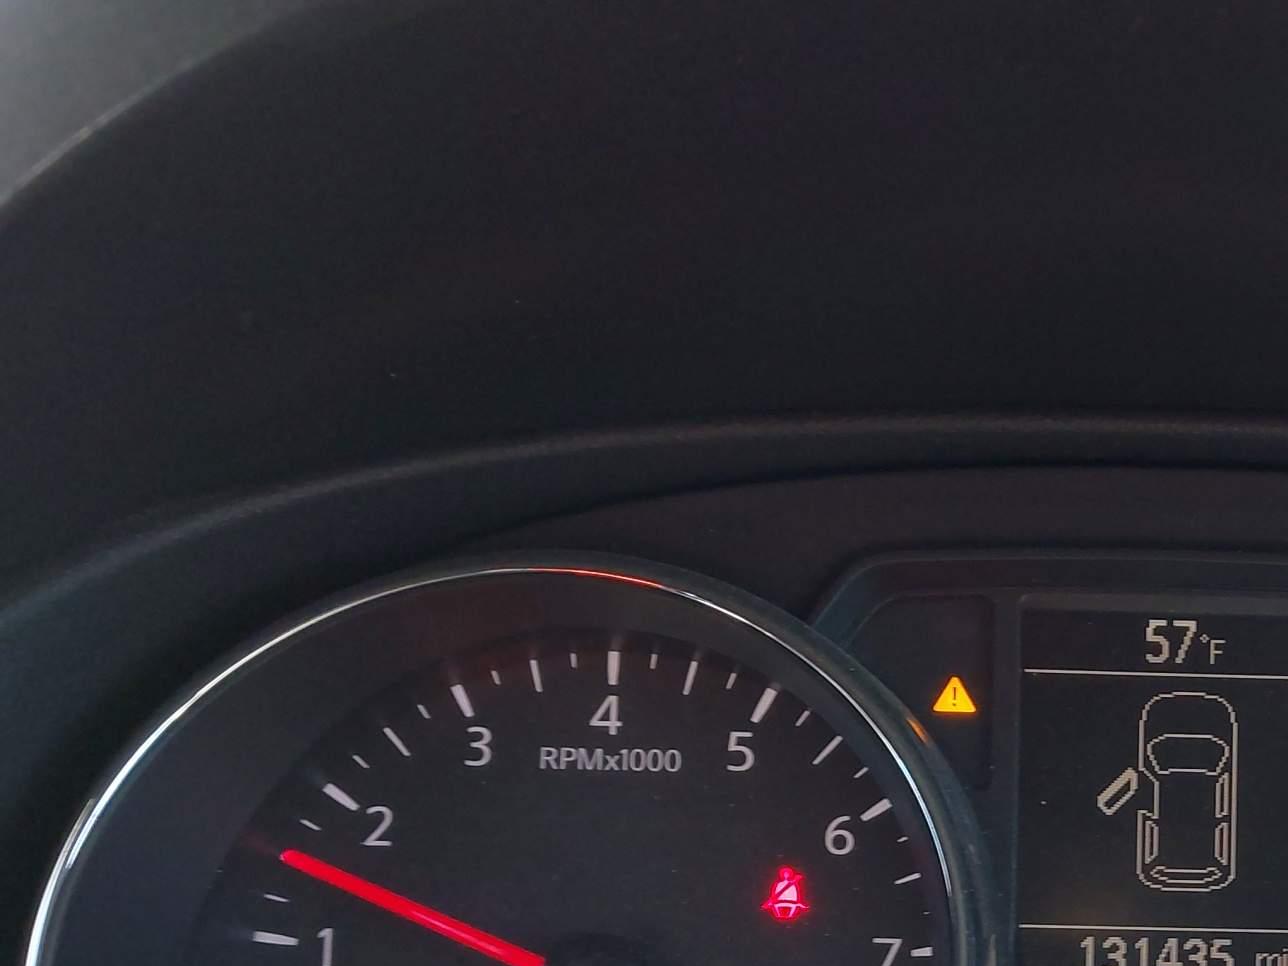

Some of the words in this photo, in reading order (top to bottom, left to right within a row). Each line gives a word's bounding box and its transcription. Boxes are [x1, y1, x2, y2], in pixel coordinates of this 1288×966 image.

[589, 695, 623, 736] 4
[464, 726, 492, 767] 3
[539, 746, 682, 773] RPMx1000
[726, 731, 755, 772] 5
[362, 805, 393, 847] 2
[824, 815, 855, 856] 6
